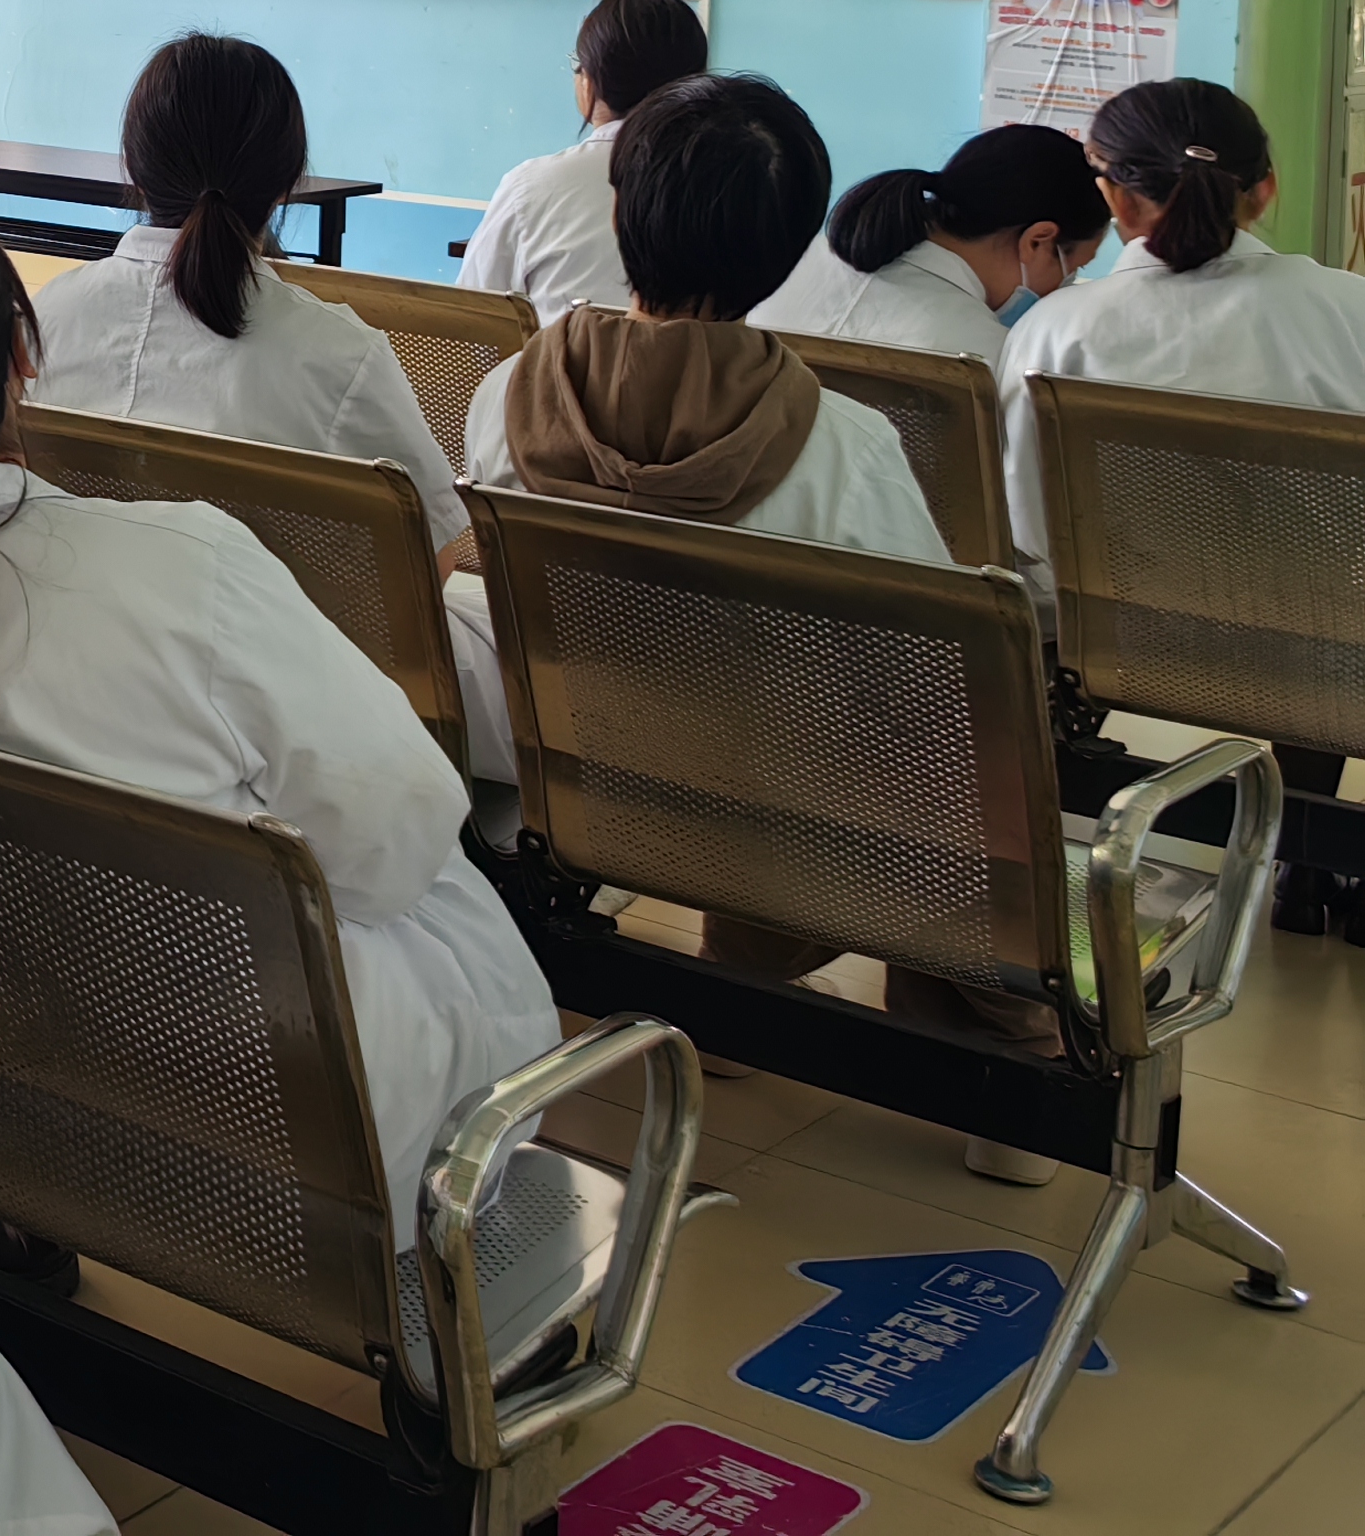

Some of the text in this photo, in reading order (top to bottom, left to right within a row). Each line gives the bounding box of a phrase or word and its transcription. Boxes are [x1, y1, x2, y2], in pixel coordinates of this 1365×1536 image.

[797, 1298, 982, 1414] 无障碍卫生间
[616, 1454, 796, 1536] 哺乳室
